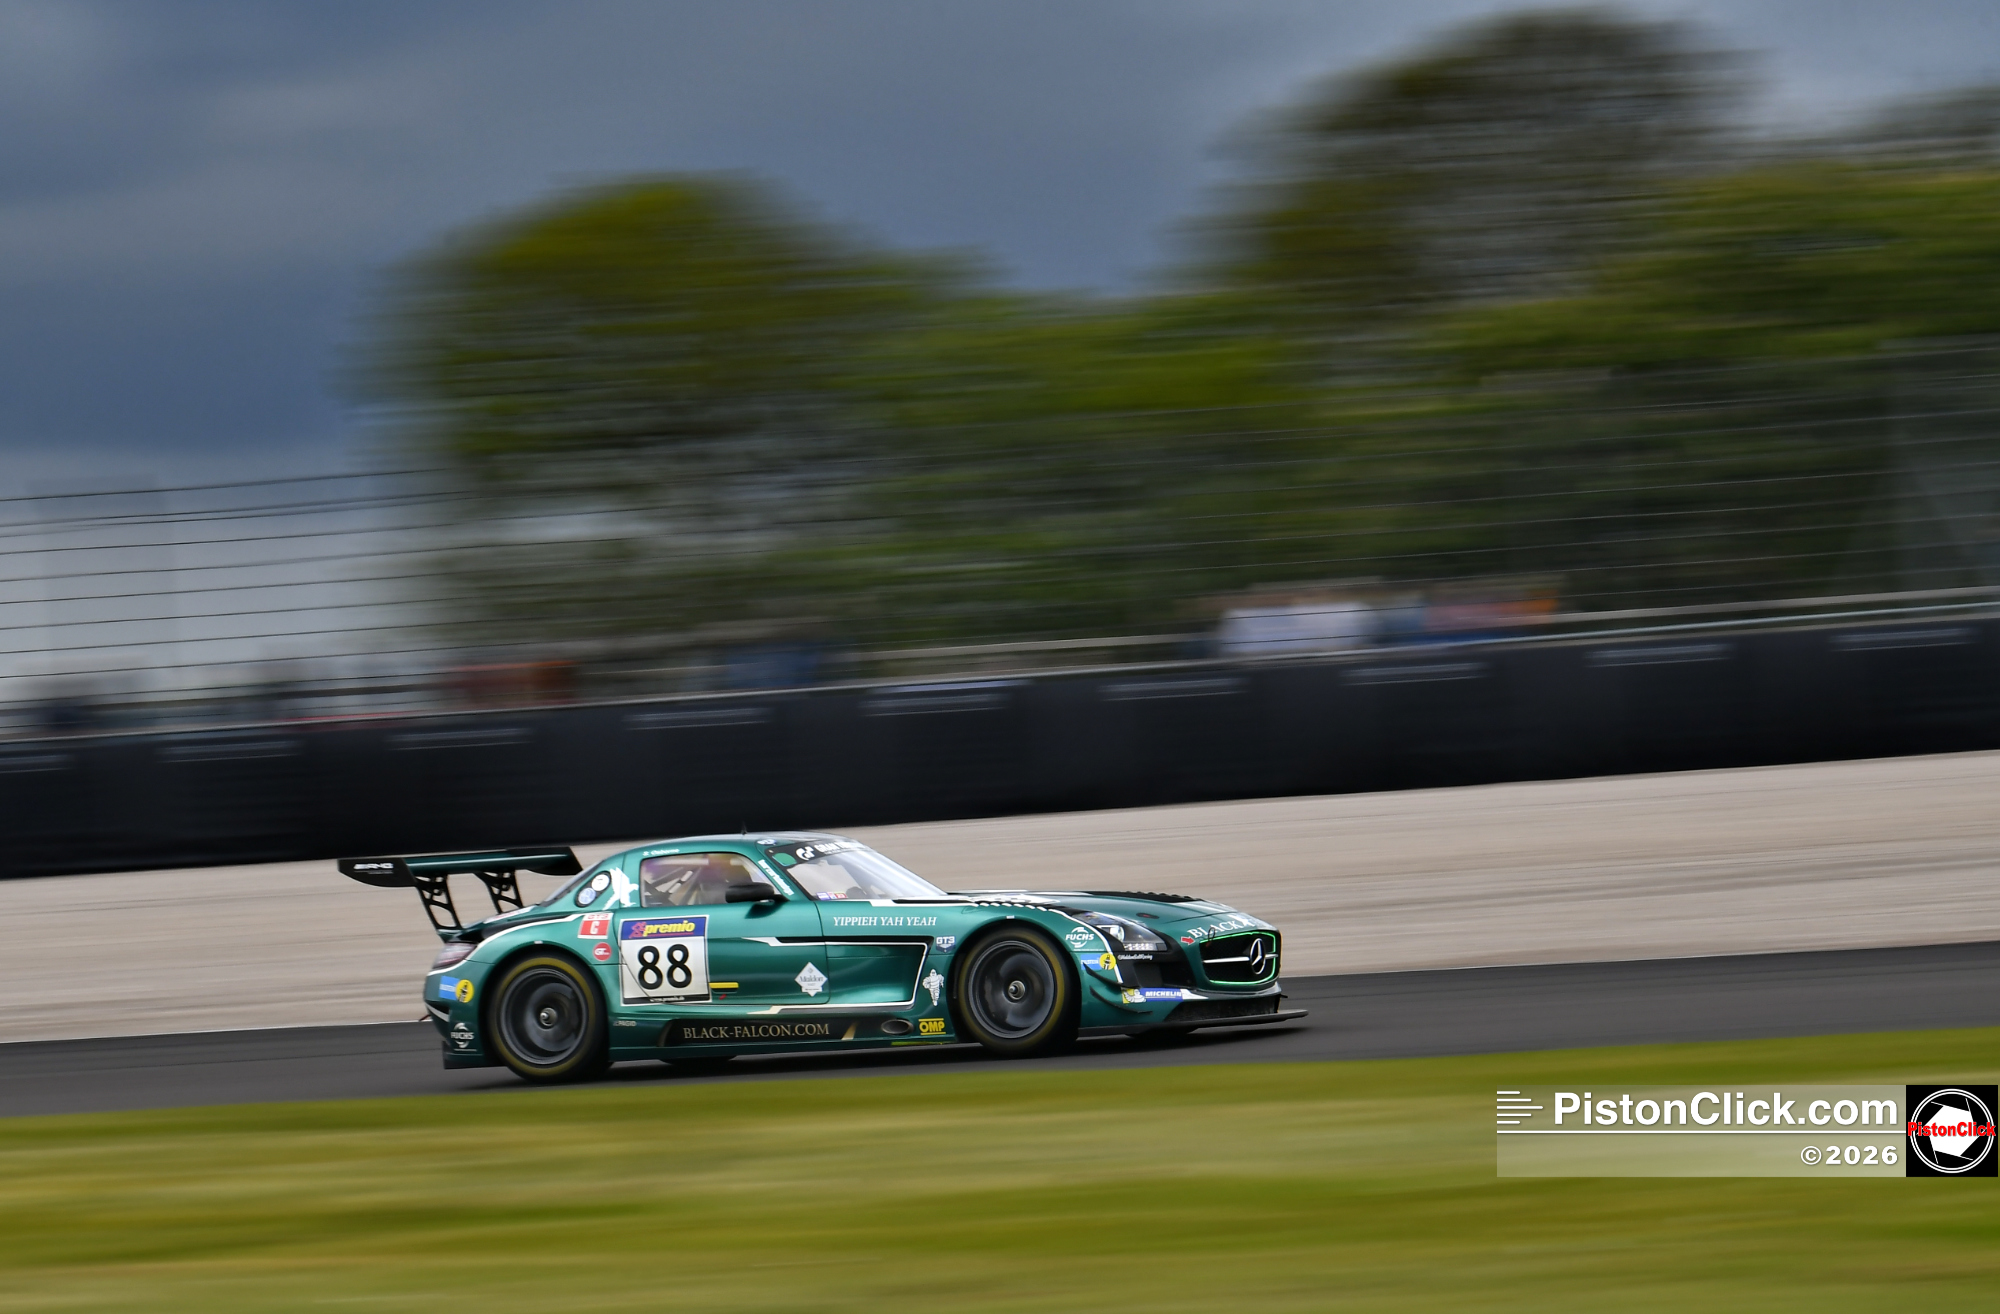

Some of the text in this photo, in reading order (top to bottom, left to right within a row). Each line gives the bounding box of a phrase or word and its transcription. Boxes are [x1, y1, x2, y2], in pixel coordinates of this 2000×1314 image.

[833, 916, 937, 926] YIPPIEH YAH YEAH
[643, 920, 695, 937] premio
[936, 936, 955, 944] GT3
[1065, 933, 1095, 941] FUCHS
[637, 943, 693, 990] 88
[682, 1023, 830, 1039] BLACK-FALCON.COM
[919, 1021, 945, 1033] OMP
[450, 1031, 475, 1040] FUCHS
